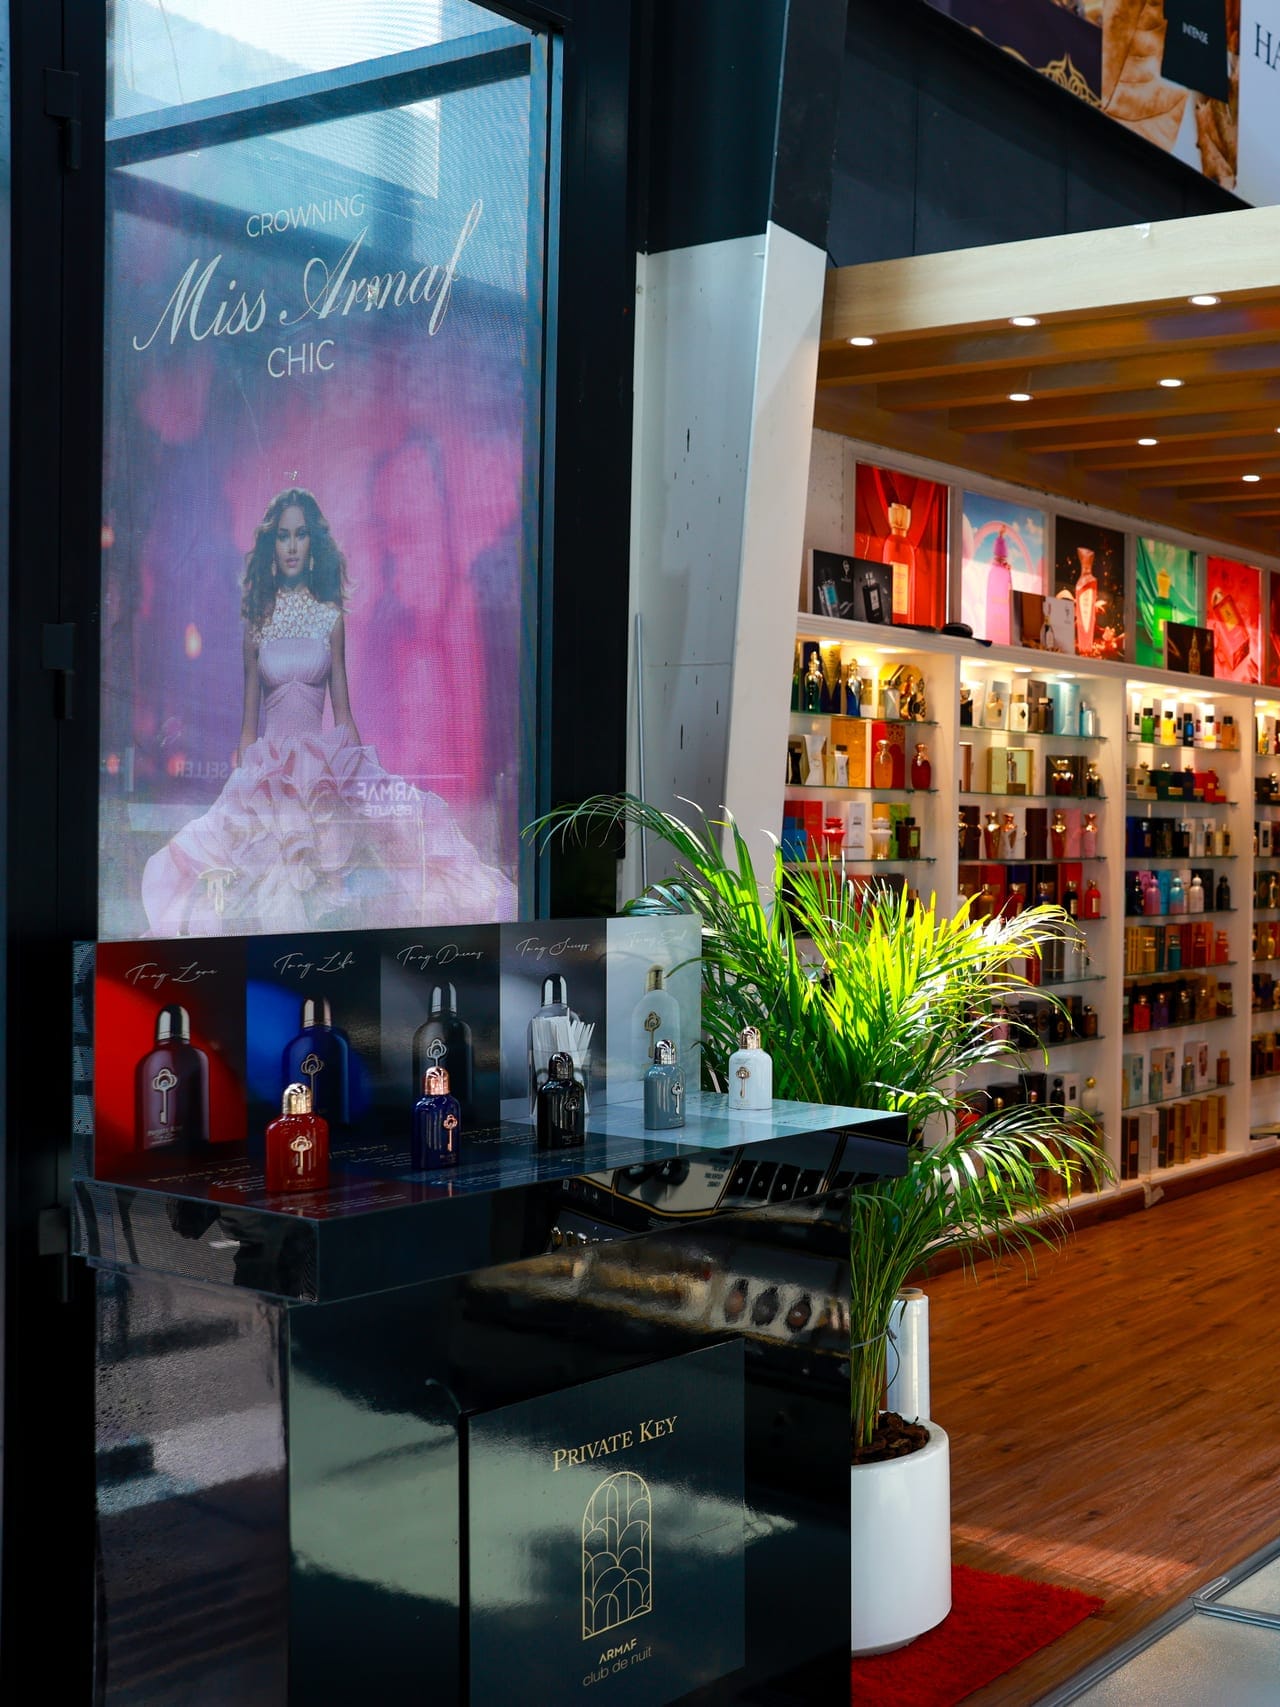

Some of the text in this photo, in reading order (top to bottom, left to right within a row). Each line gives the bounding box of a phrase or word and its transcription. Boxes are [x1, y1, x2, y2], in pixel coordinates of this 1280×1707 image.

[1182, 22, 1209, 45] INTENSE
[246, 193, 366, 238] CROWNING
[133, 198, 483, 351] Miss Armaf
[267, 339, 335, 378] CHIC
[552, 1415, 678, 1473] PRIVATE KEY
[582, 1646, 653, 1687] club de nuit
[598, 1637, 638, 1665] ARMAF
